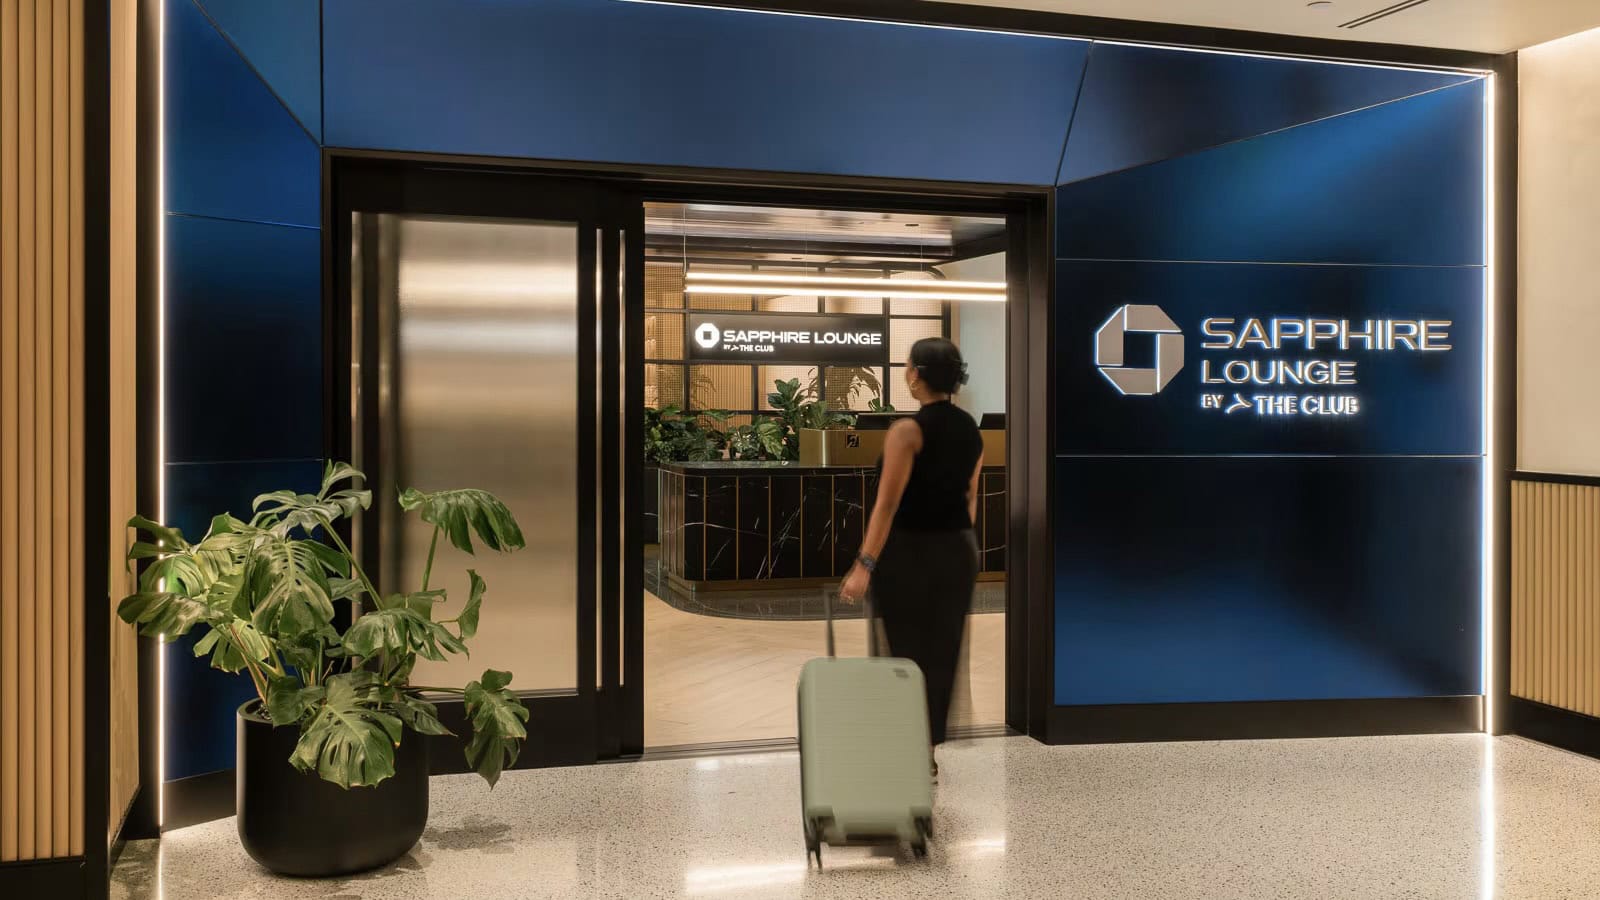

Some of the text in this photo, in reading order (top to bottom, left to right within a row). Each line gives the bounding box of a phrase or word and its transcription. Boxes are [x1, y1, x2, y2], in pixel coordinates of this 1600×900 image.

[723, 330, 882, 345] SAPPHIRE LOUNGE
[1201, 317, 1452, 350] SAPPHIRE
[739, 344, 754, 352] THE
[1201, 360, 1358, 385] LOUNGE
[1201, 394, 1360, 415] BY THE CLUB
